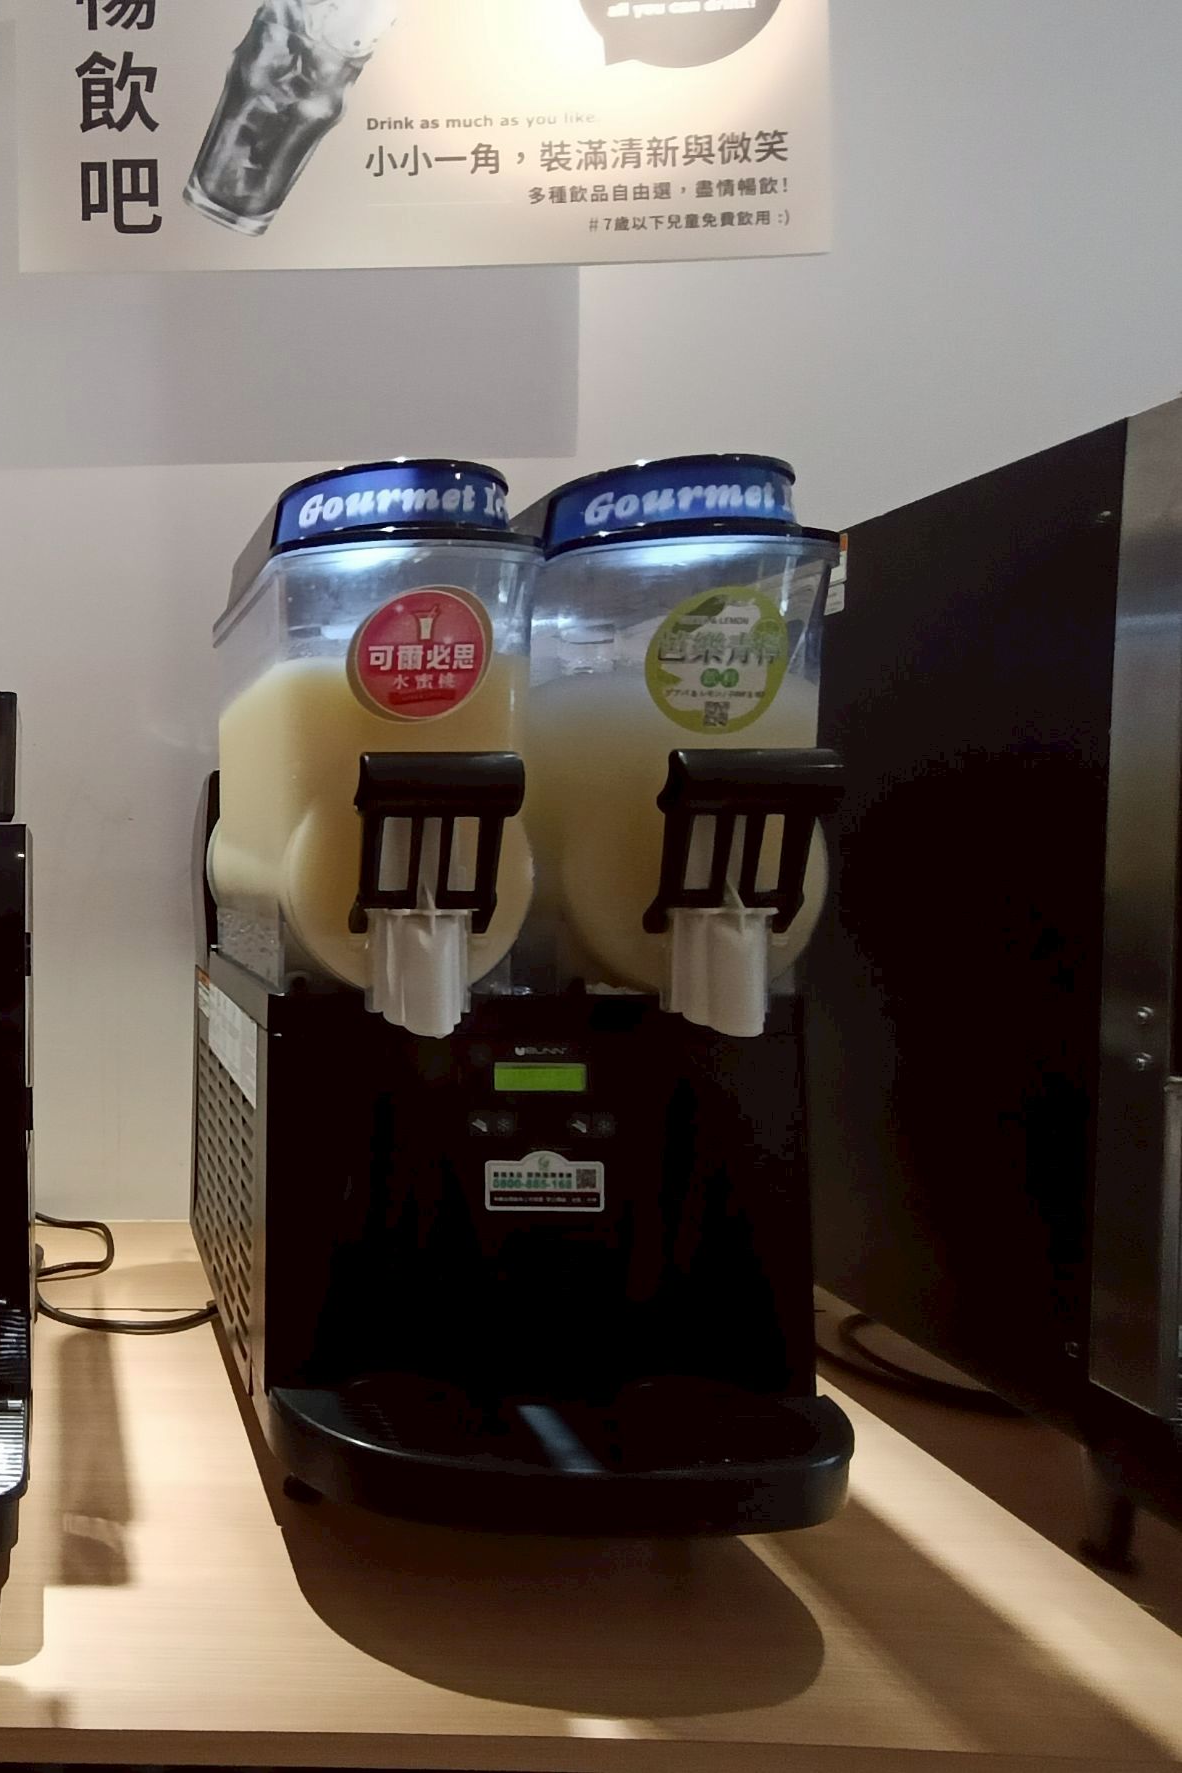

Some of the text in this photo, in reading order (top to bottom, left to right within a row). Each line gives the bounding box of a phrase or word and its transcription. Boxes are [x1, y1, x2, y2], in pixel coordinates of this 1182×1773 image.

[366, 116, 414, 130] Drink
[420, 118, 440, 129] as
[446, 115, 493, 129] much
[500, 116, 519, 126] as
[526, 114, 557, 128] you
[365, 130, 789, 177] 小小一角，裝滿清新與微笑
[298, 484, 476, 529] Gourmet
[584, 482, 775, 526] Gourmet
[719, 617, 749, 625] LEMON
[368, 643, 475, 671] 可爾必思
[393, 673, 457, 690] 水蜜桃
